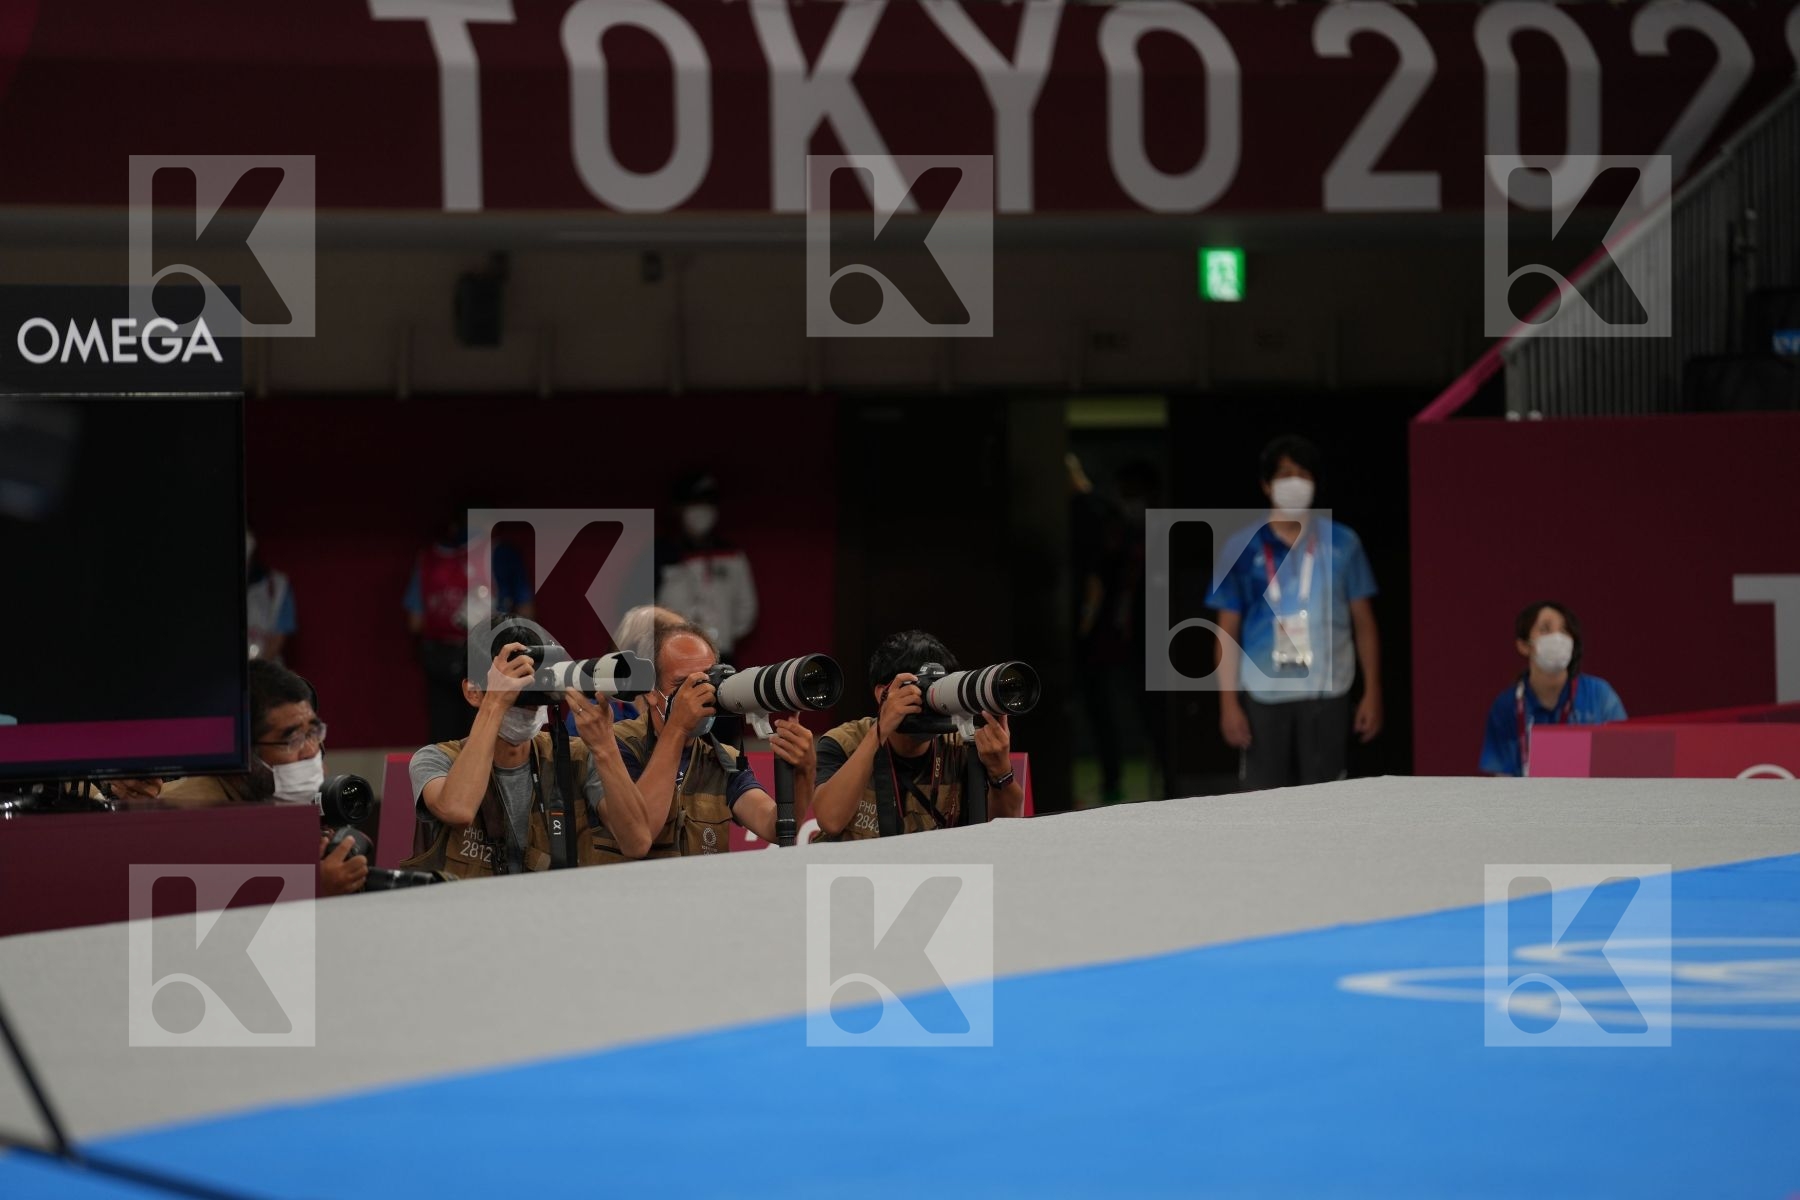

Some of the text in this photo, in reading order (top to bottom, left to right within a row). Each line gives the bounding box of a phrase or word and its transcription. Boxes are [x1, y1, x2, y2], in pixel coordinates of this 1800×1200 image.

[369, 0, 1800, 213] TOKYO 202
[16, 316, 224, 365] OMEGA
[460, 840, 494, 863] 2812
